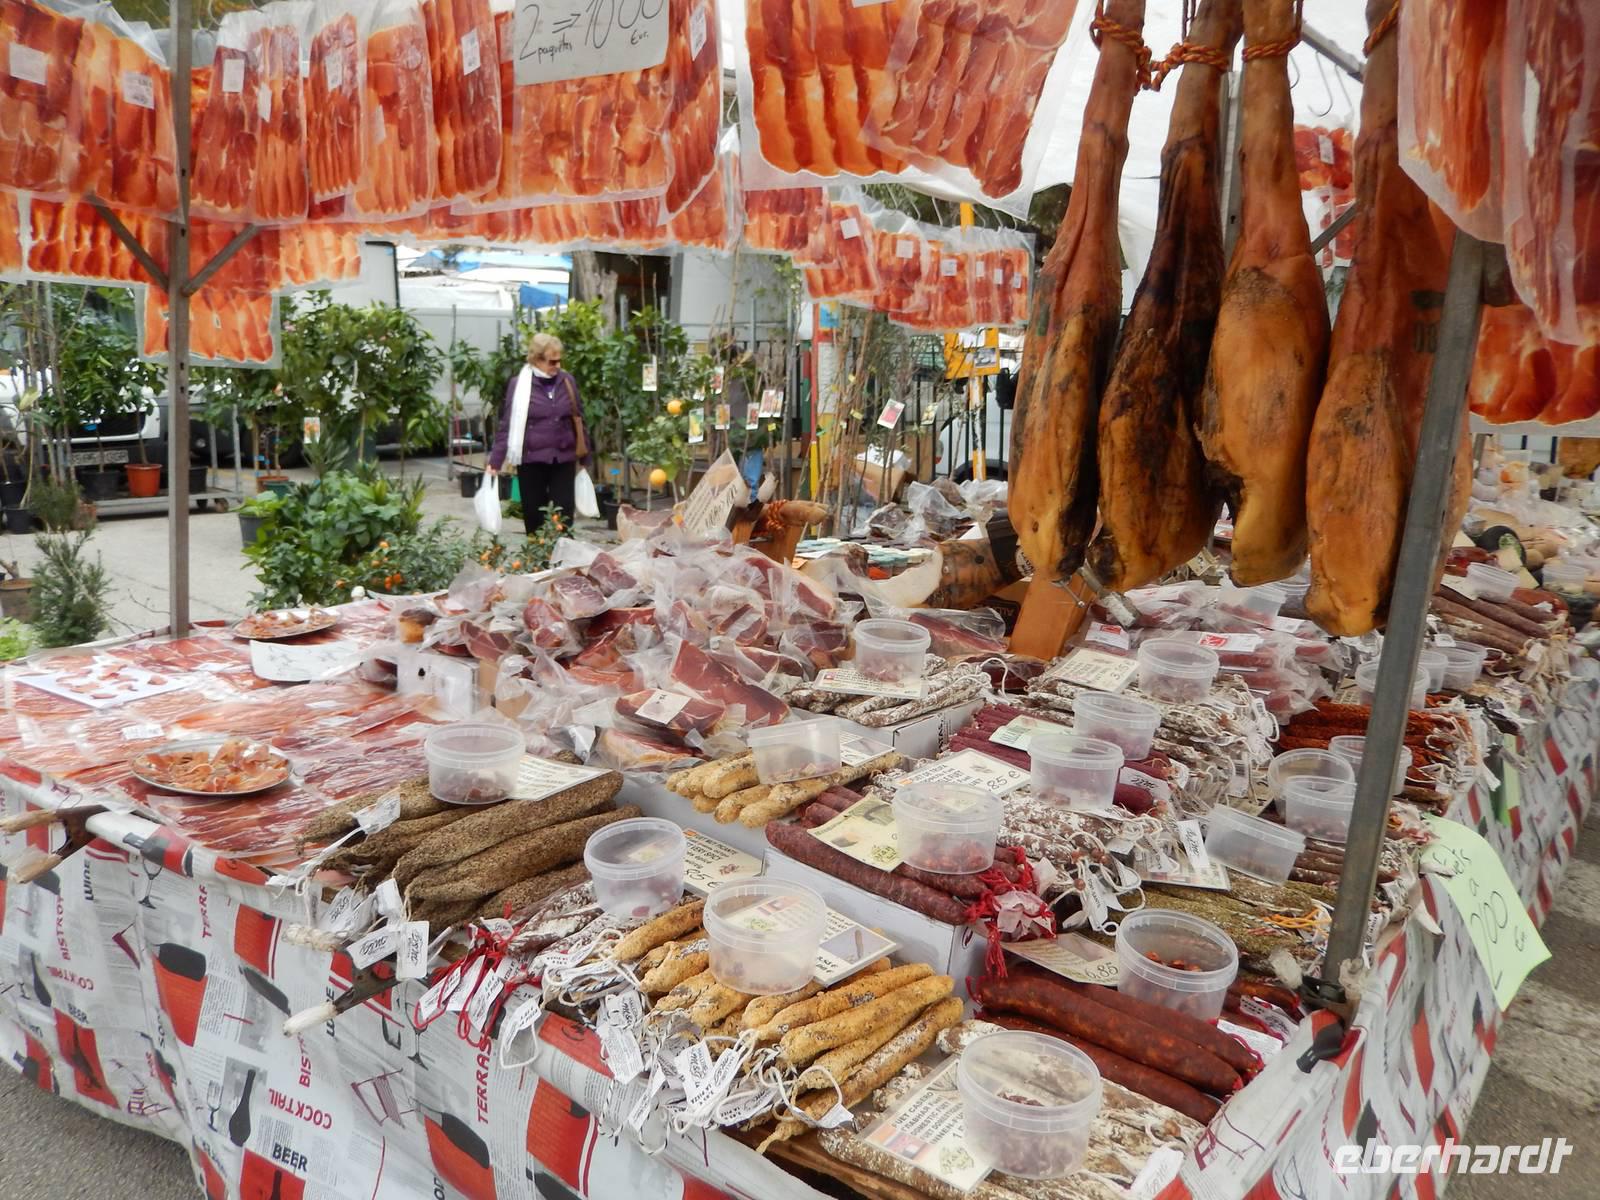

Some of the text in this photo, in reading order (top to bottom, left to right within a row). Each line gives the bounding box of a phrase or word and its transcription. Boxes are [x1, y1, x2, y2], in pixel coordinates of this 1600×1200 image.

[519, 4, 540, 60] 2
[268, 1087, 333, 1131] COCKTAIL
[910, 1091, 934, 1113] CASERO
[271, 1143, 309, 1173] BEER
